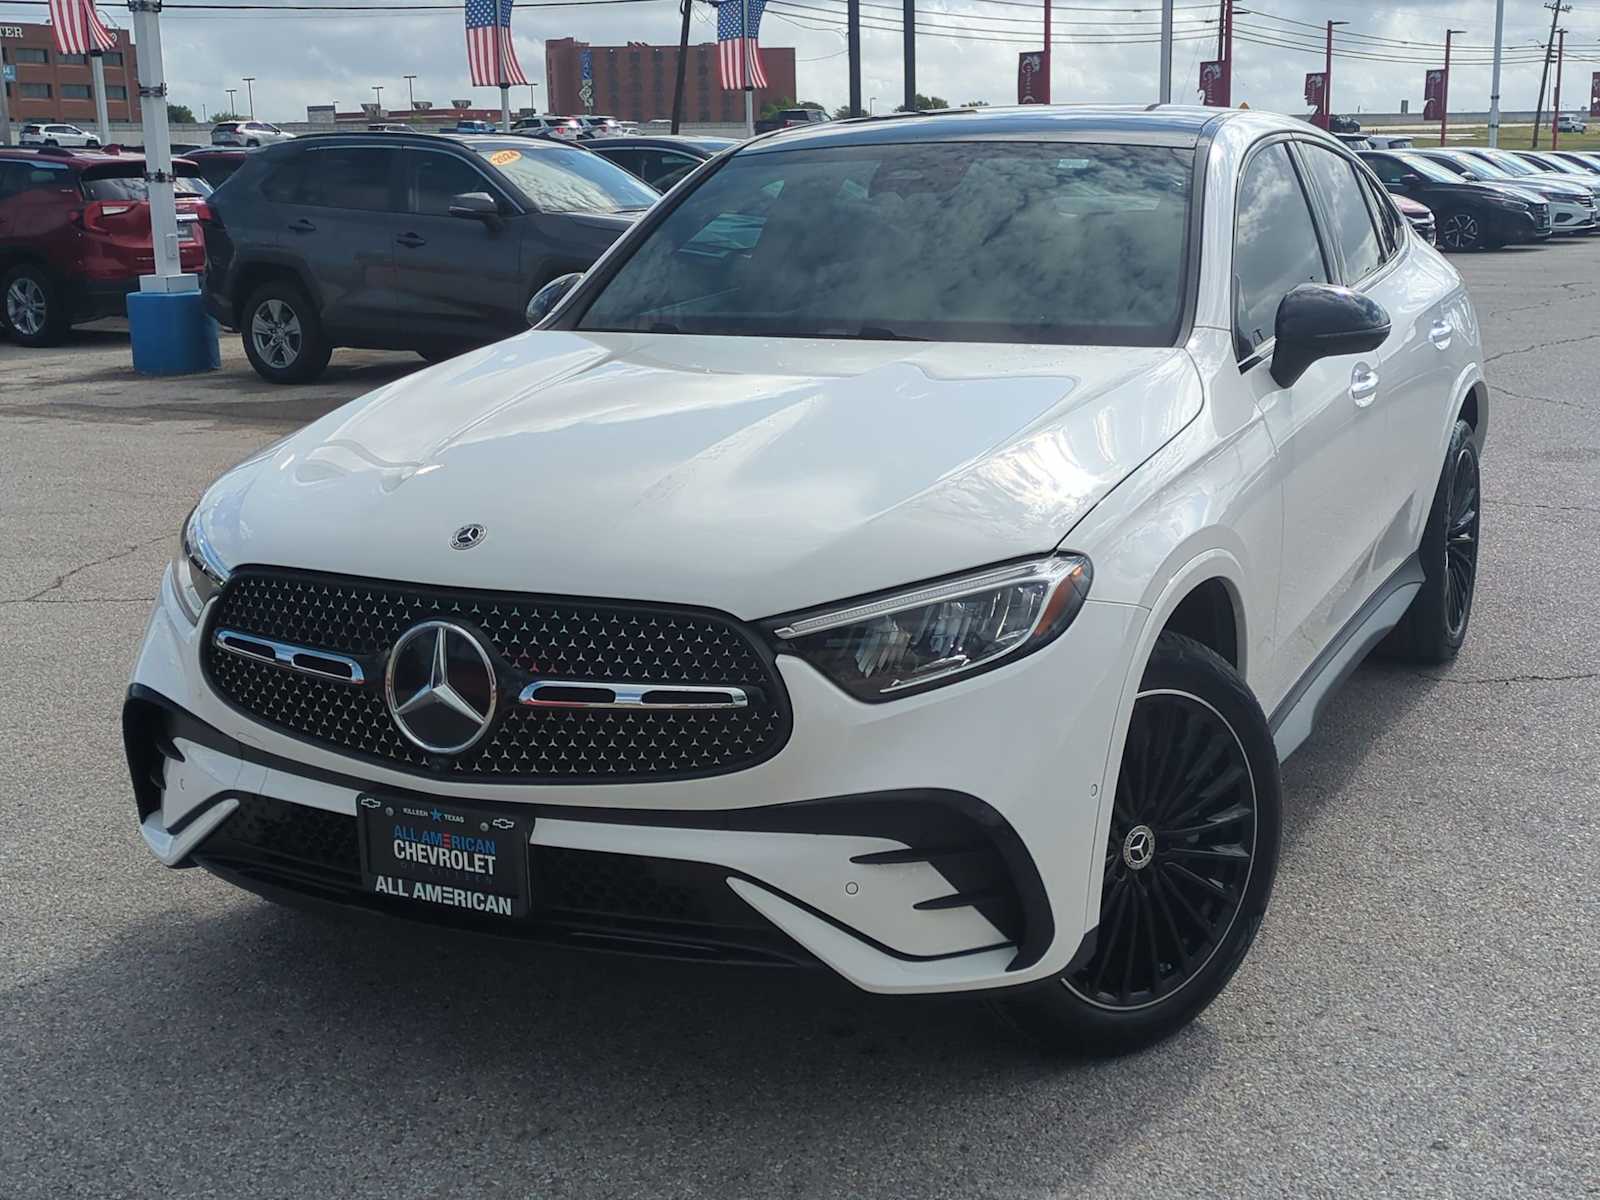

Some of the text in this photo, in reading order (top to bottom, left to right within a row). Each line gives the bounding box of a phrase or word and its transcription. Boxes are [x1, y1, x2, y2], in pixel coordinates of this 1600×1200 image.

[403, 807, 465, 823] KILLEEN TEXAS
[394, 825, 496, 855] ALL AMERICAN
[394, 839, 496, 875] CHEVROLET
[375, 875, 512, 916] ALL AMERICAN
